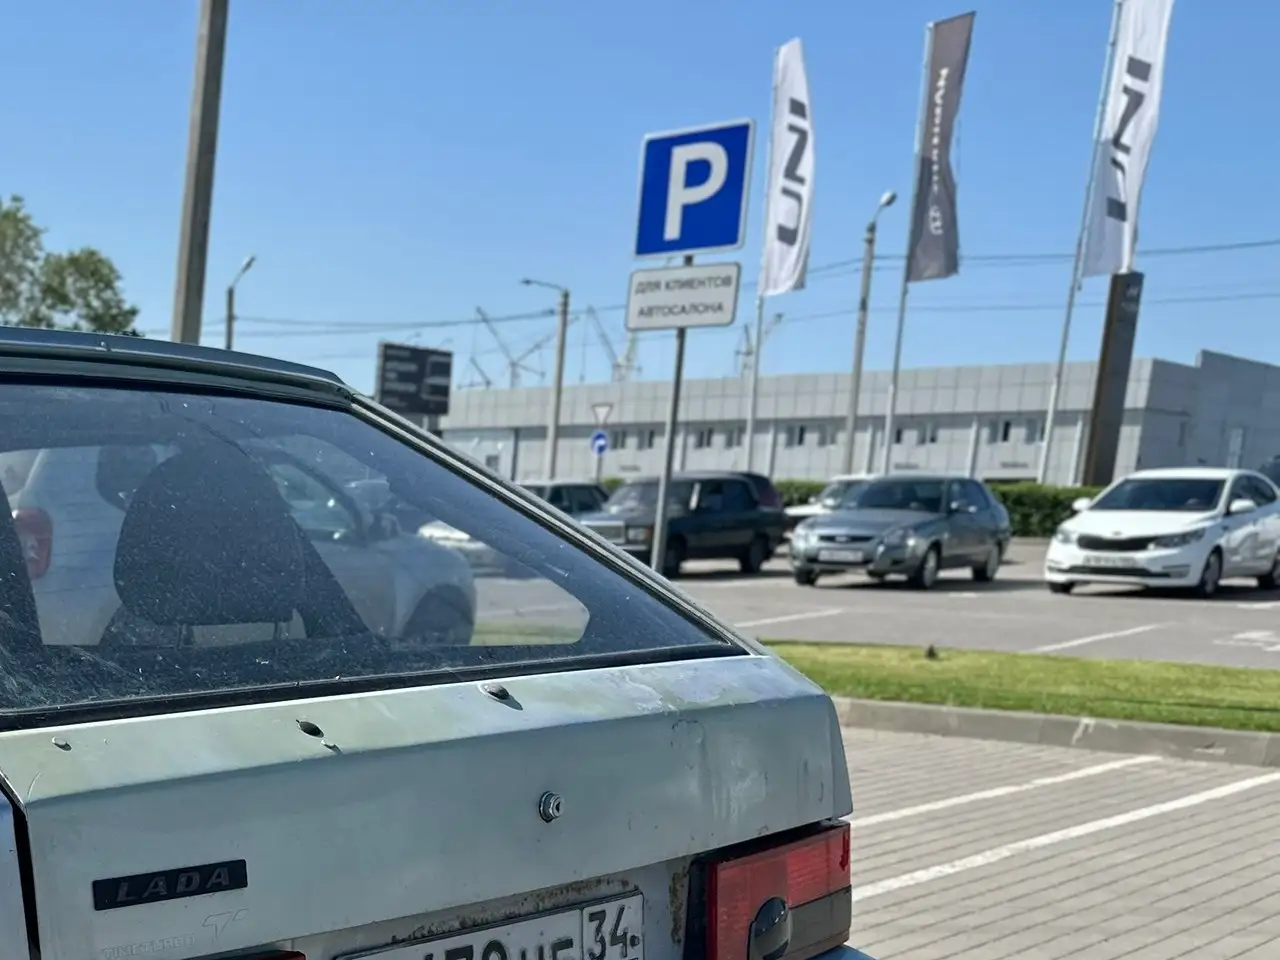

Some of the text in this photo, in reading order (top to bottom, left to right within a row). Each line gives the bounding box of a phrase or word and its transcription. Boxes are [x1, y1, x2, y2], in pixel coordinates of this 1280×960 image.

[776, 96, 809, 247] UNI
[663, 141, 729, 242] P
[634, 274, 733, 296] ДЛЯ КЛИЕНТОВ
[638, 302, 724, 318] АВТОСАЛОНА
[117, 866, 231, 902] LADA
